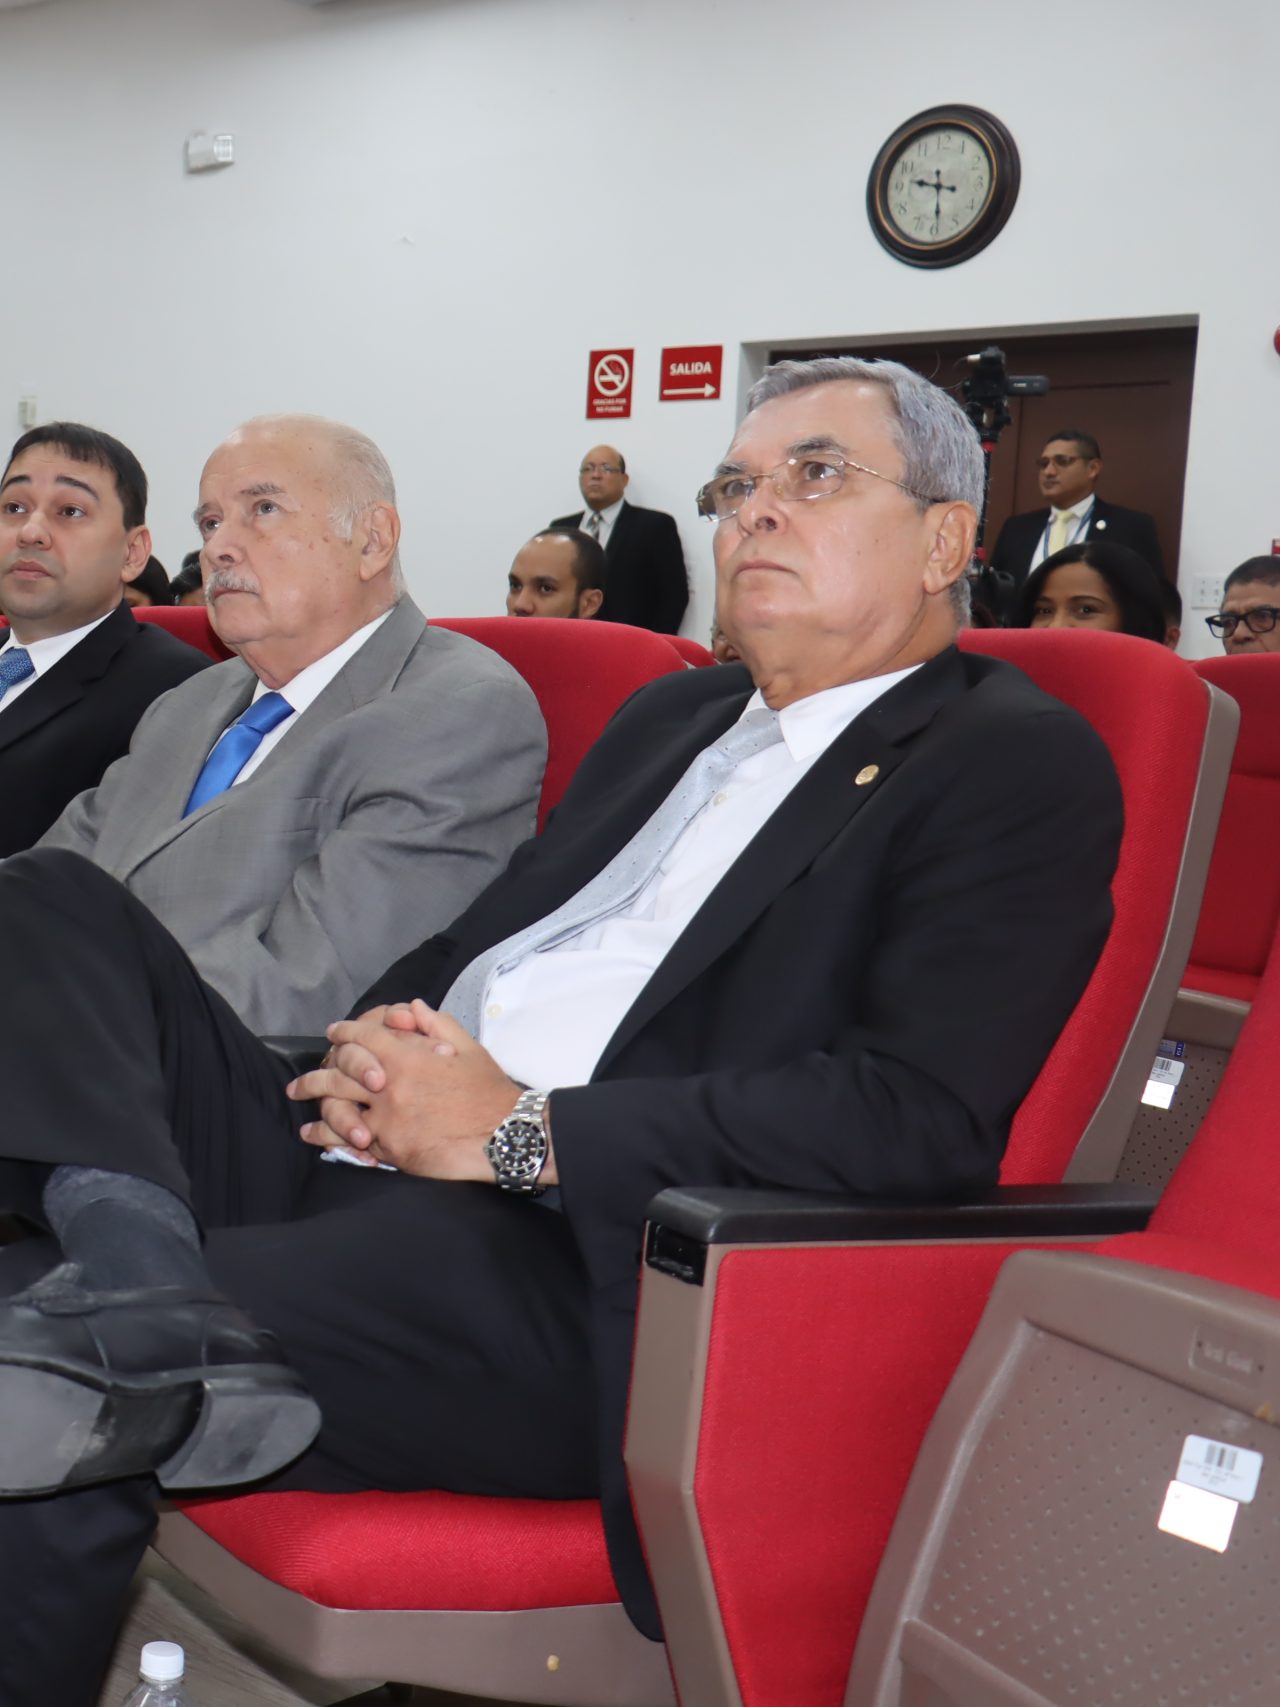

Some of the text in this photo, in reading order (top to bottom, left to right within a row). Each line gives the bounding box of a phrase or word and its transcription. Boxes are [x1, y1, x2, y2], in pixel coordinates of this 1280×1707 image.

[918, 142, 928, 157] 11
[937, 134, 952, 150] 12
[901, 160, 915, 176] 10
[971, 155, 981, 171] 2
[895, 181, 904, 193] 9
[669, 361, 712, 375] SALIDA
